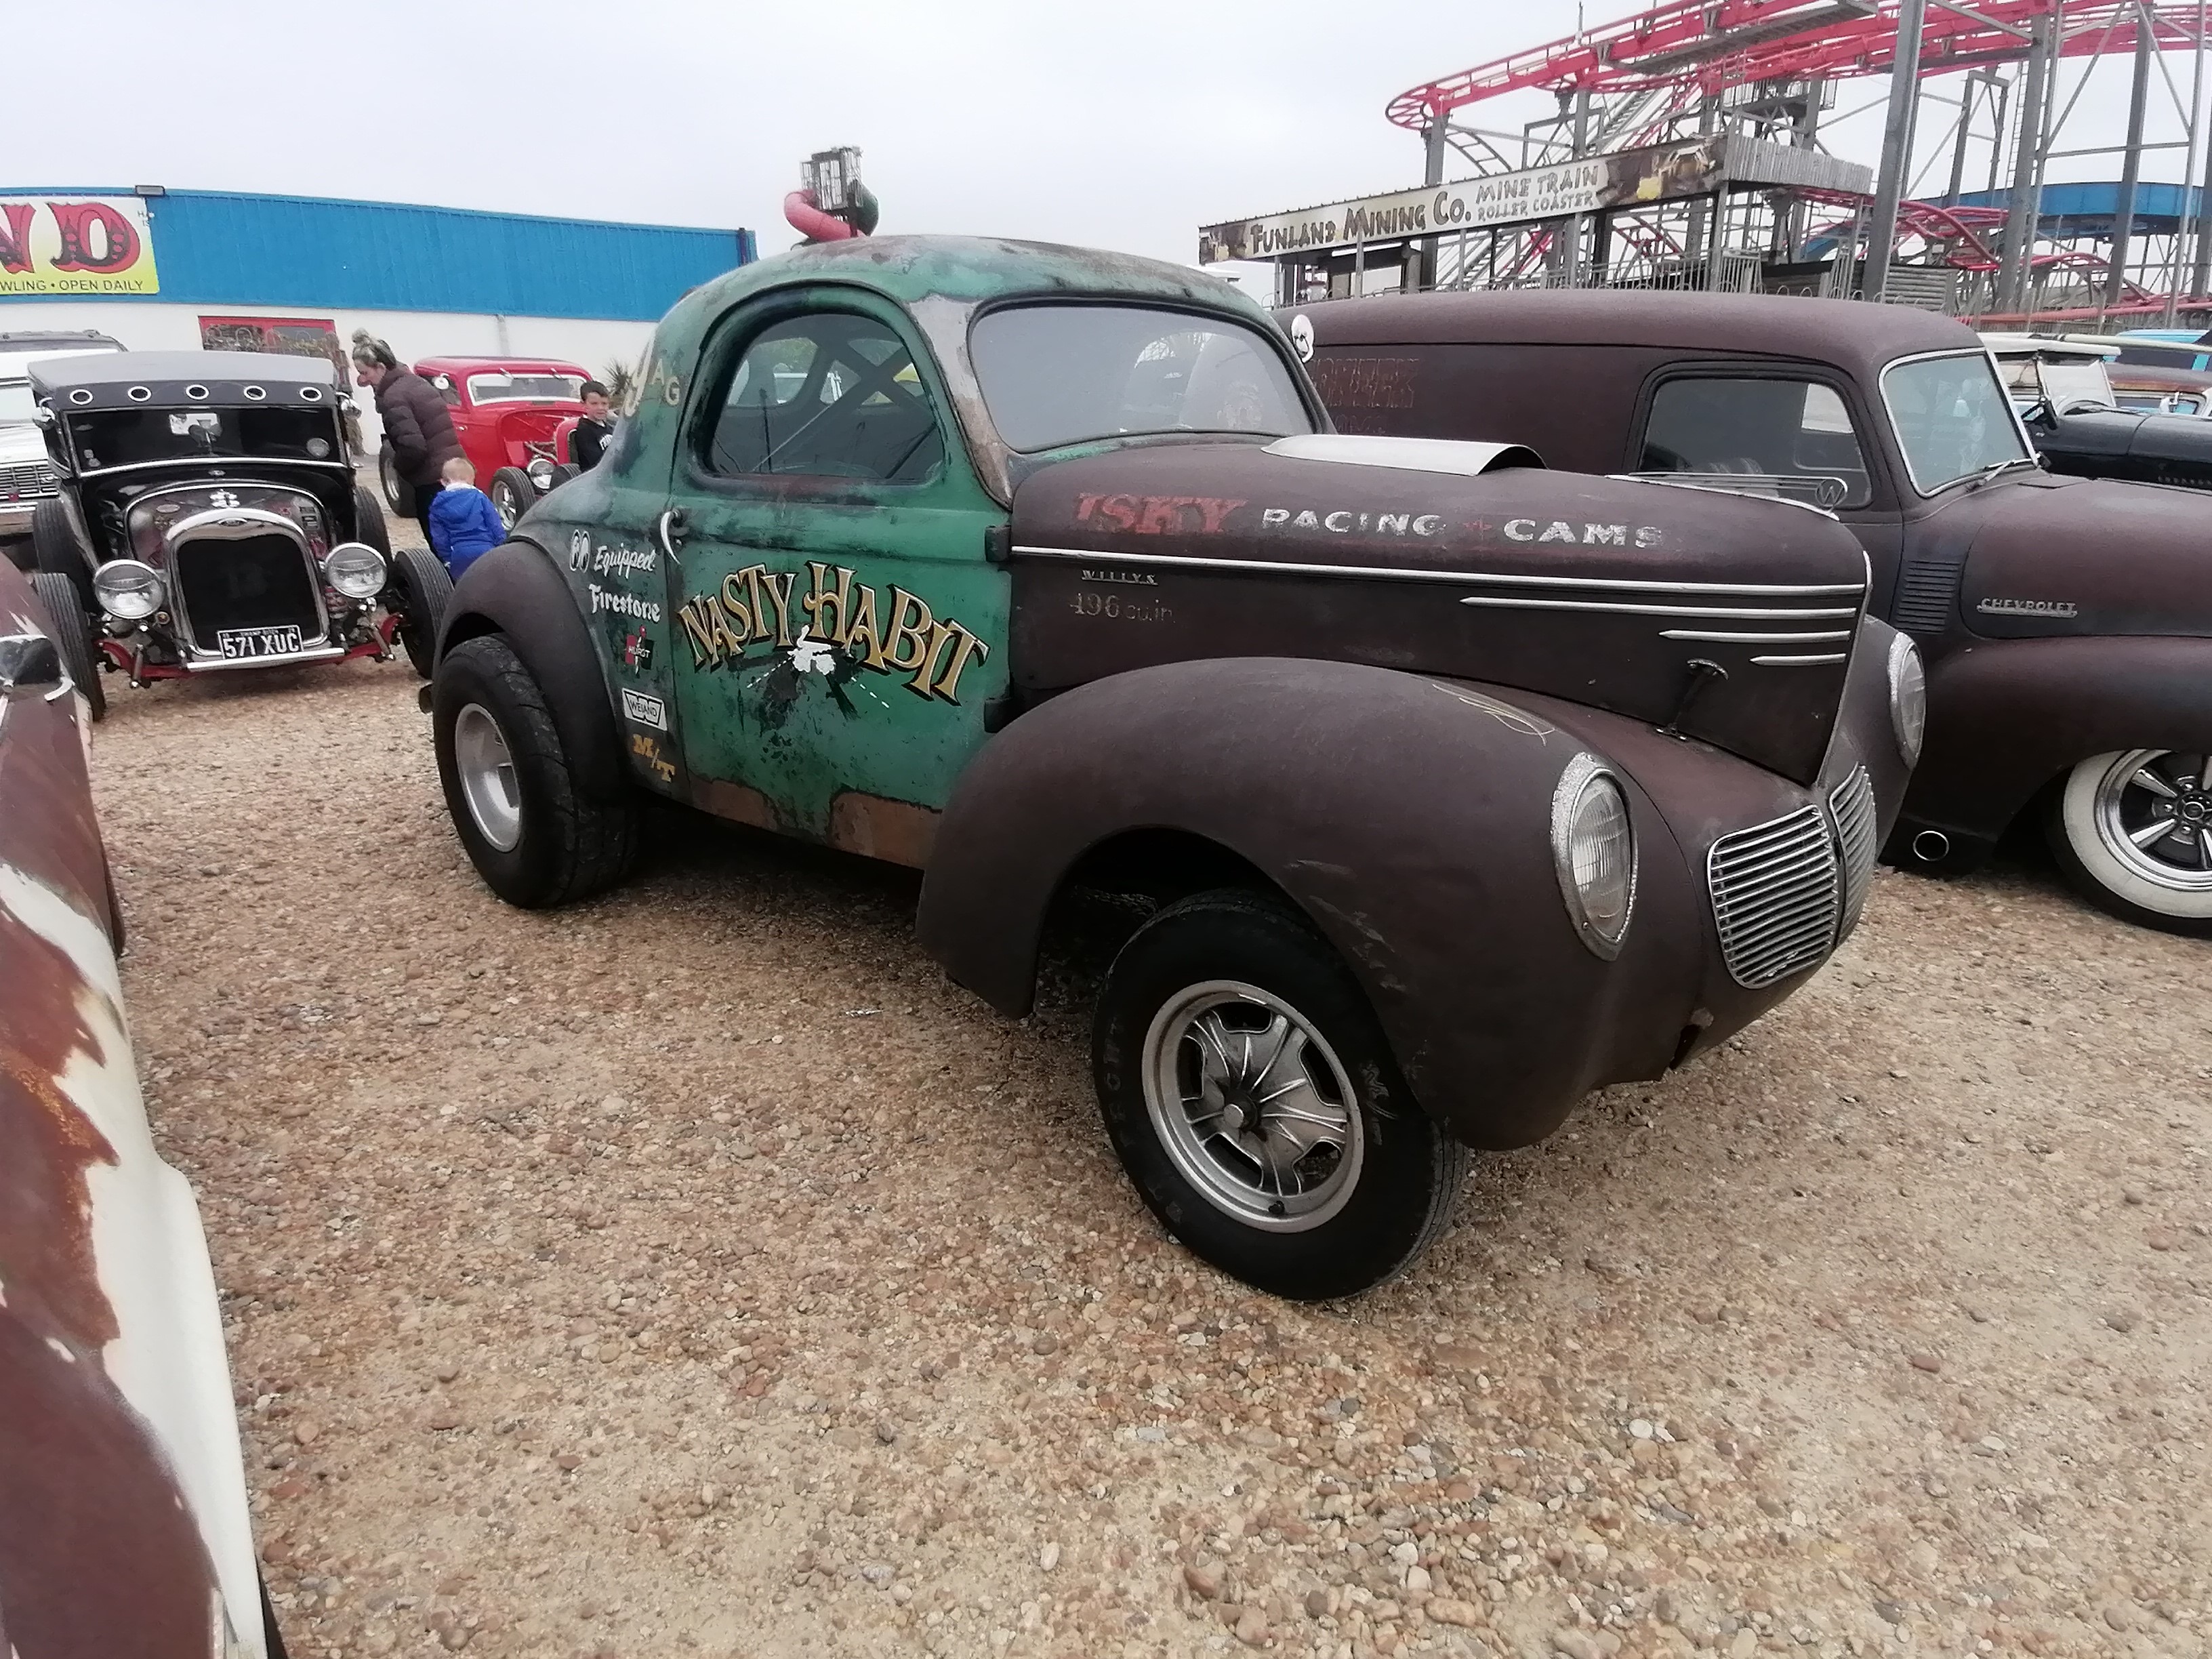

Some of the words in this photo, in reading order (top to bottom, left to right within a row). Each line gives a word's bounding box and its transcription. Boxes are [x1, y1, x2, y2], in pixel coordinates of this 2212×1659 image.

[1475, 178, 1532, 204] MINE
[1536, 165, 1599, 196] TRAIN
[1477, 201, 1528, 222] ROLLER
[1532, 190, 1594, 212] COASTER
[1250, 220, 1336, 255] FUNLAND
[1343, 204, 1426, 241] MINING
[59, 280, 98, 291] OPEN
[103, 280, 143, 291] DAILY
[1503, 518, 1662, 548] CAMS
[589, 583, 661, 622] Firestone
[1980, 598, 2077, 615] CHEVROLET
[223, 636, 256, 657] 571
[260, 632, 300, 655] XUC
[678, 563, 798, 672] NASTY
[804, 560, 991, 706] HABIT
[628, 644, 651, 659] HURST
